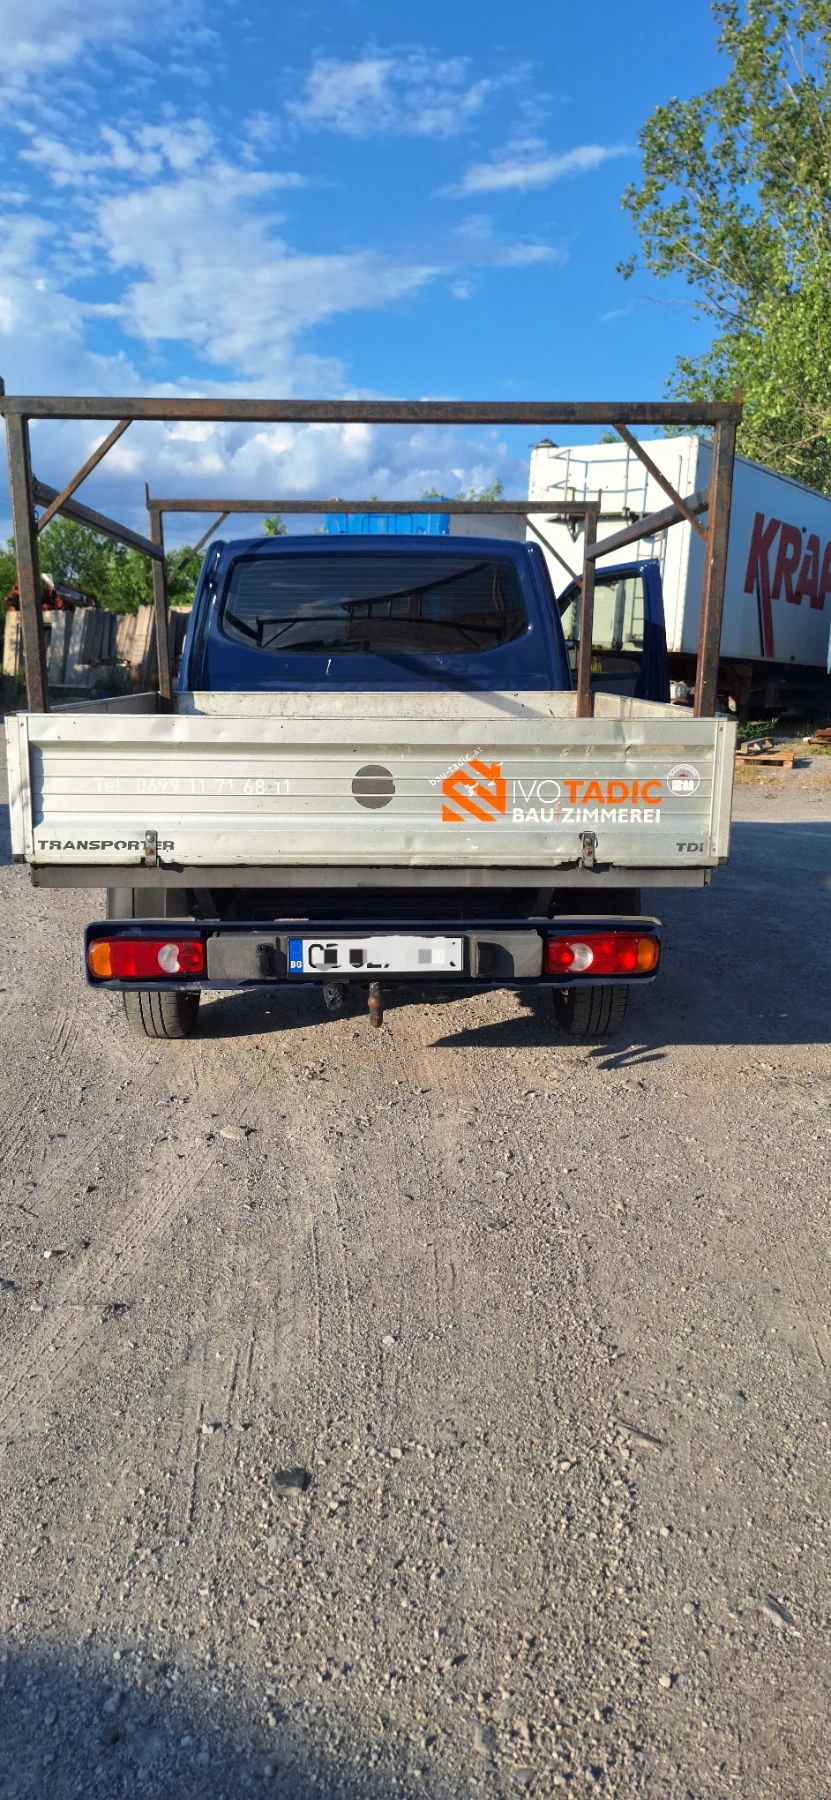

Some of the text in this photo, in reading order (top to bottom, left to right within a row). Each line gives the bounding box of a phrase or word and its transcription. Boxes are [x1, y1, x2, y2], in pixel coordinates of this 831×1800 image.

[428, 746, 483, 786] bau-tadic.at
[95, 777, 122, 793] Tel
[136, 777, 180, 794] 0699
[189, 778, 205, 794] 11
[244, 779, 265, 795] 68
[512, 779, 663, 805] IVO TADIC
[512, 807, 661, 823] BAU ZIMMEREI
